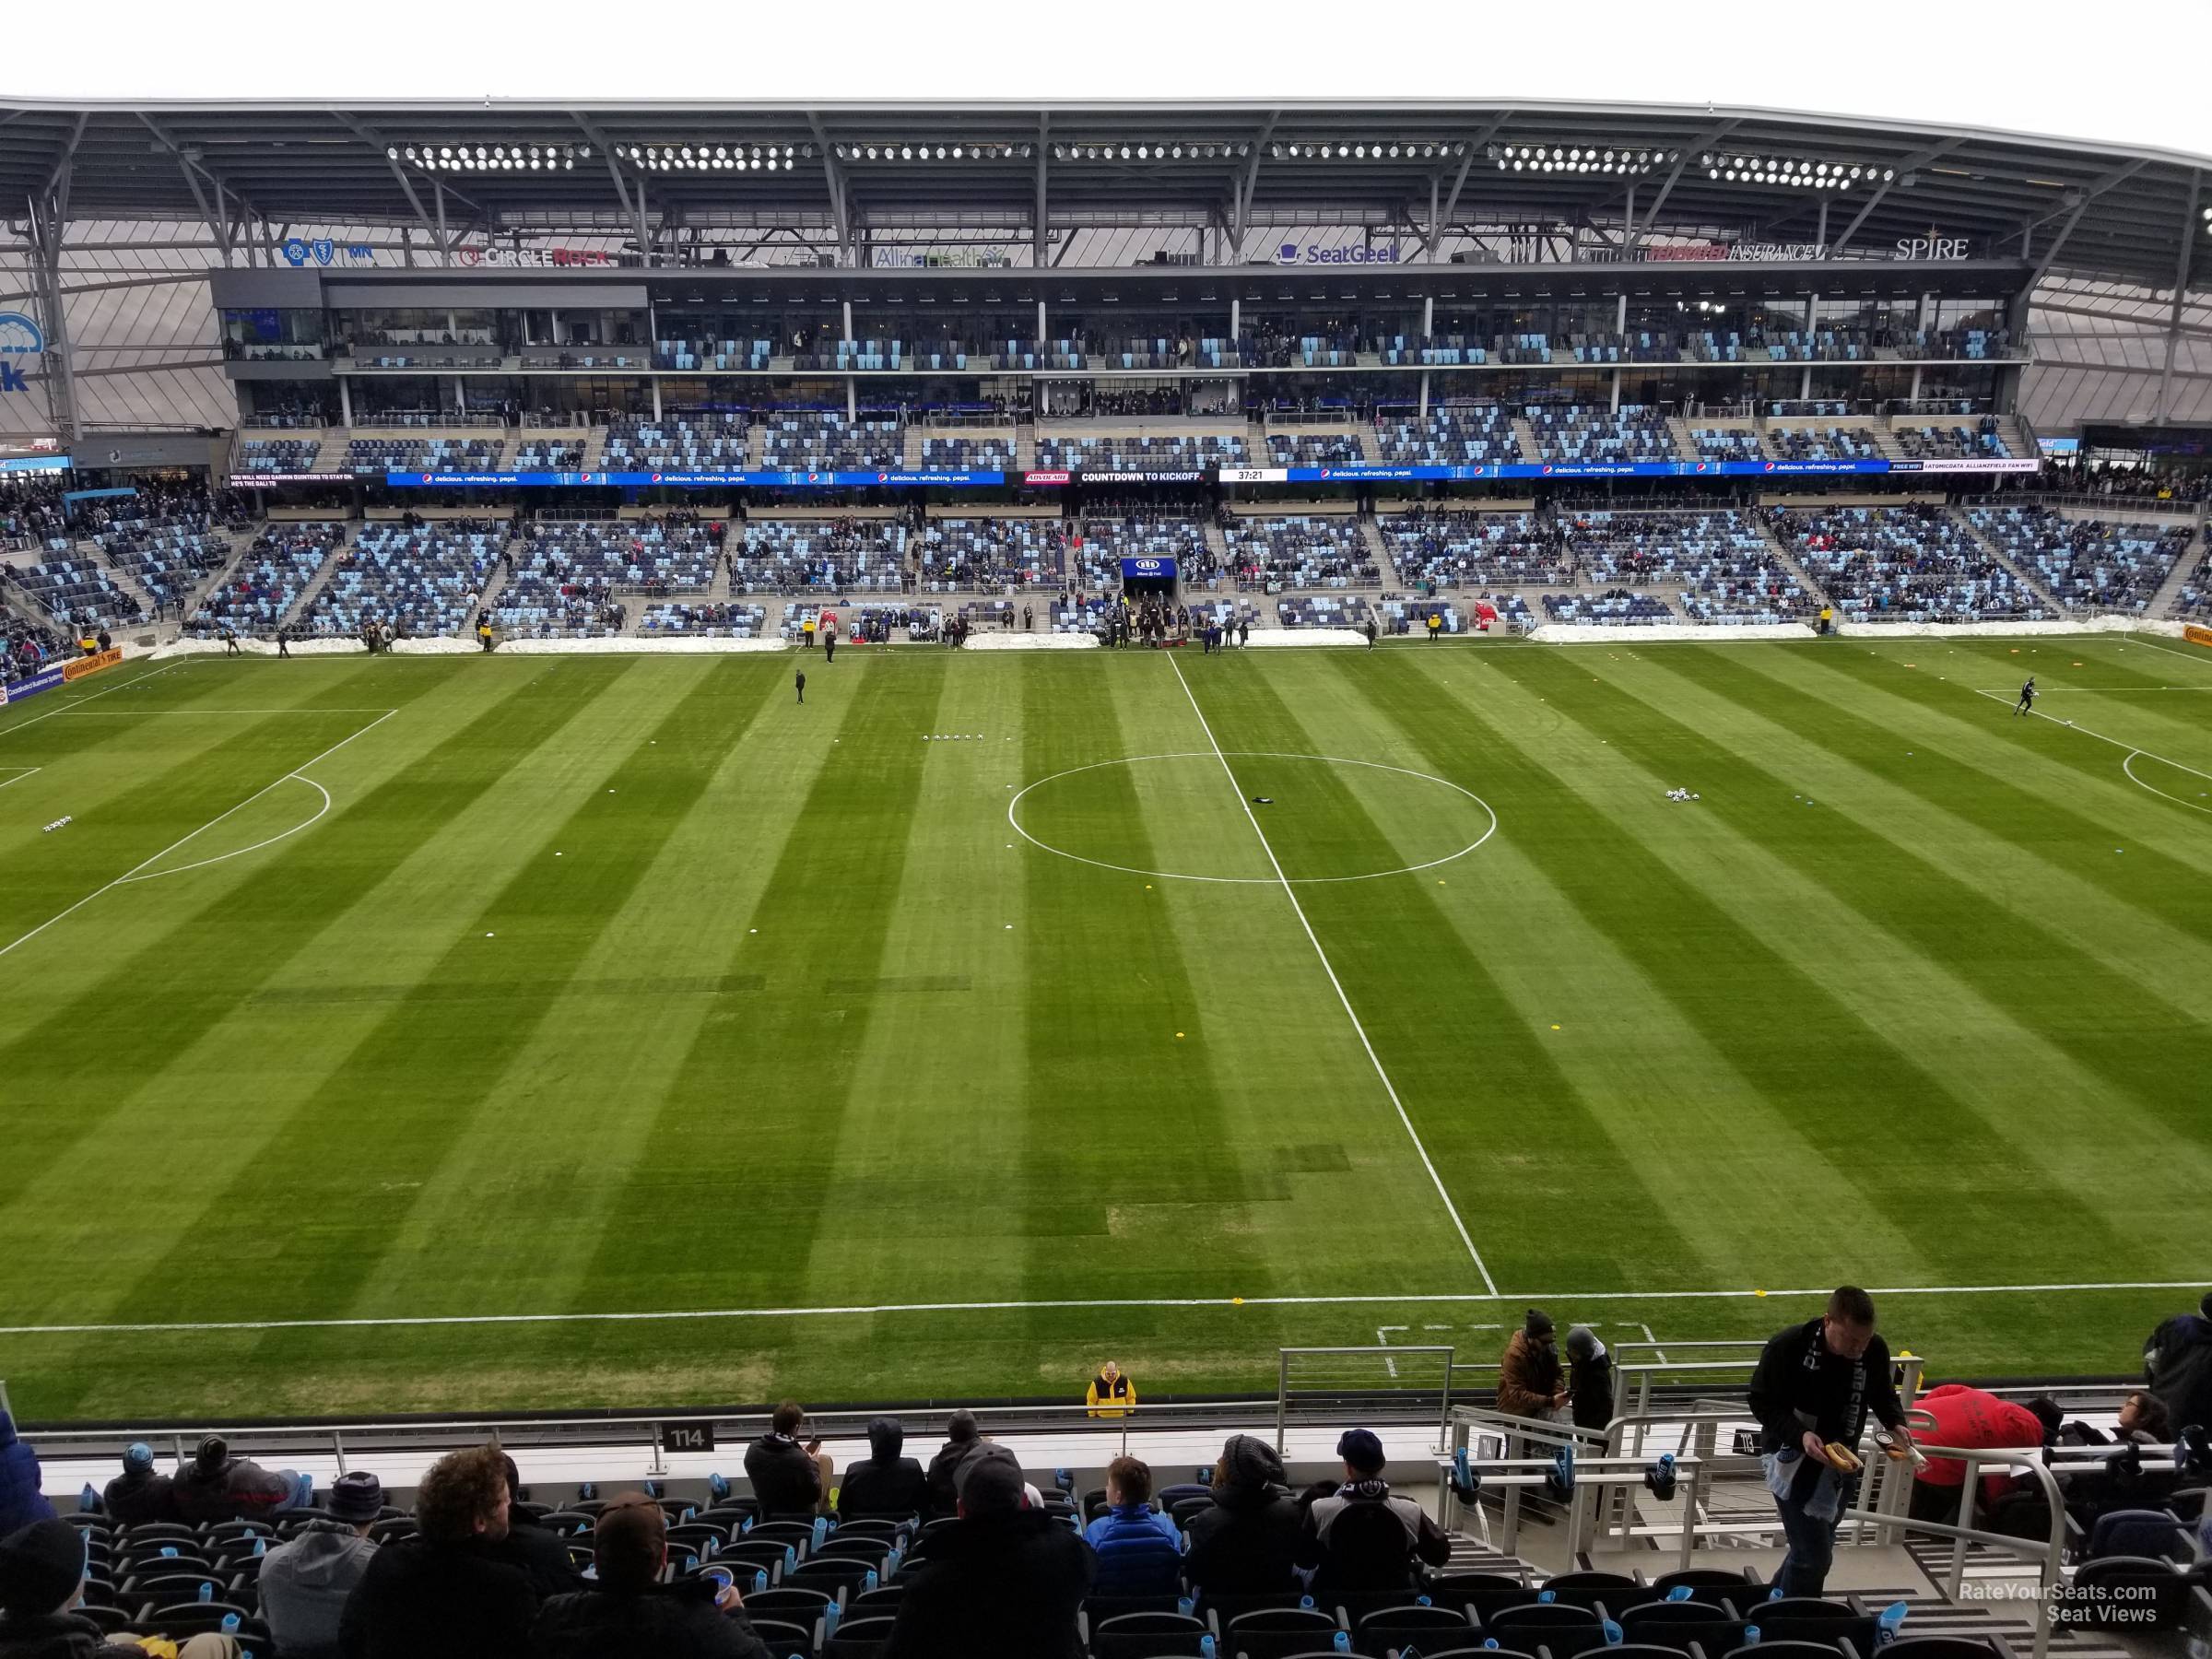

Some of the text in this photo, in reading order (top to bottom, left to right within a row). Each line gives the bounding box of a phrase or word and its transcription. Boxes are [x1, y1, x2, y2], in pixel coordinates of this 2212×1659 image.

[877, 247, 982, 267] Allina Health
[1307, 244, 1400, 264] SeatGeek
[1728, 244, 1813, 261] INSURANCE
[1895, 238, 1970, 260] SPIRE
[1026, 473, 1069, 482] ADVOCARE
[1082, 472, 1200, 481] COUNTDOWN TO KICKOFF
[1238, 471, 1263, 480] 37:21
[65, 652, 121, 680] Continental TIRE
[670, 1429, 705, 1447] 114
[1741, 1433, 1754, 1453] 113
